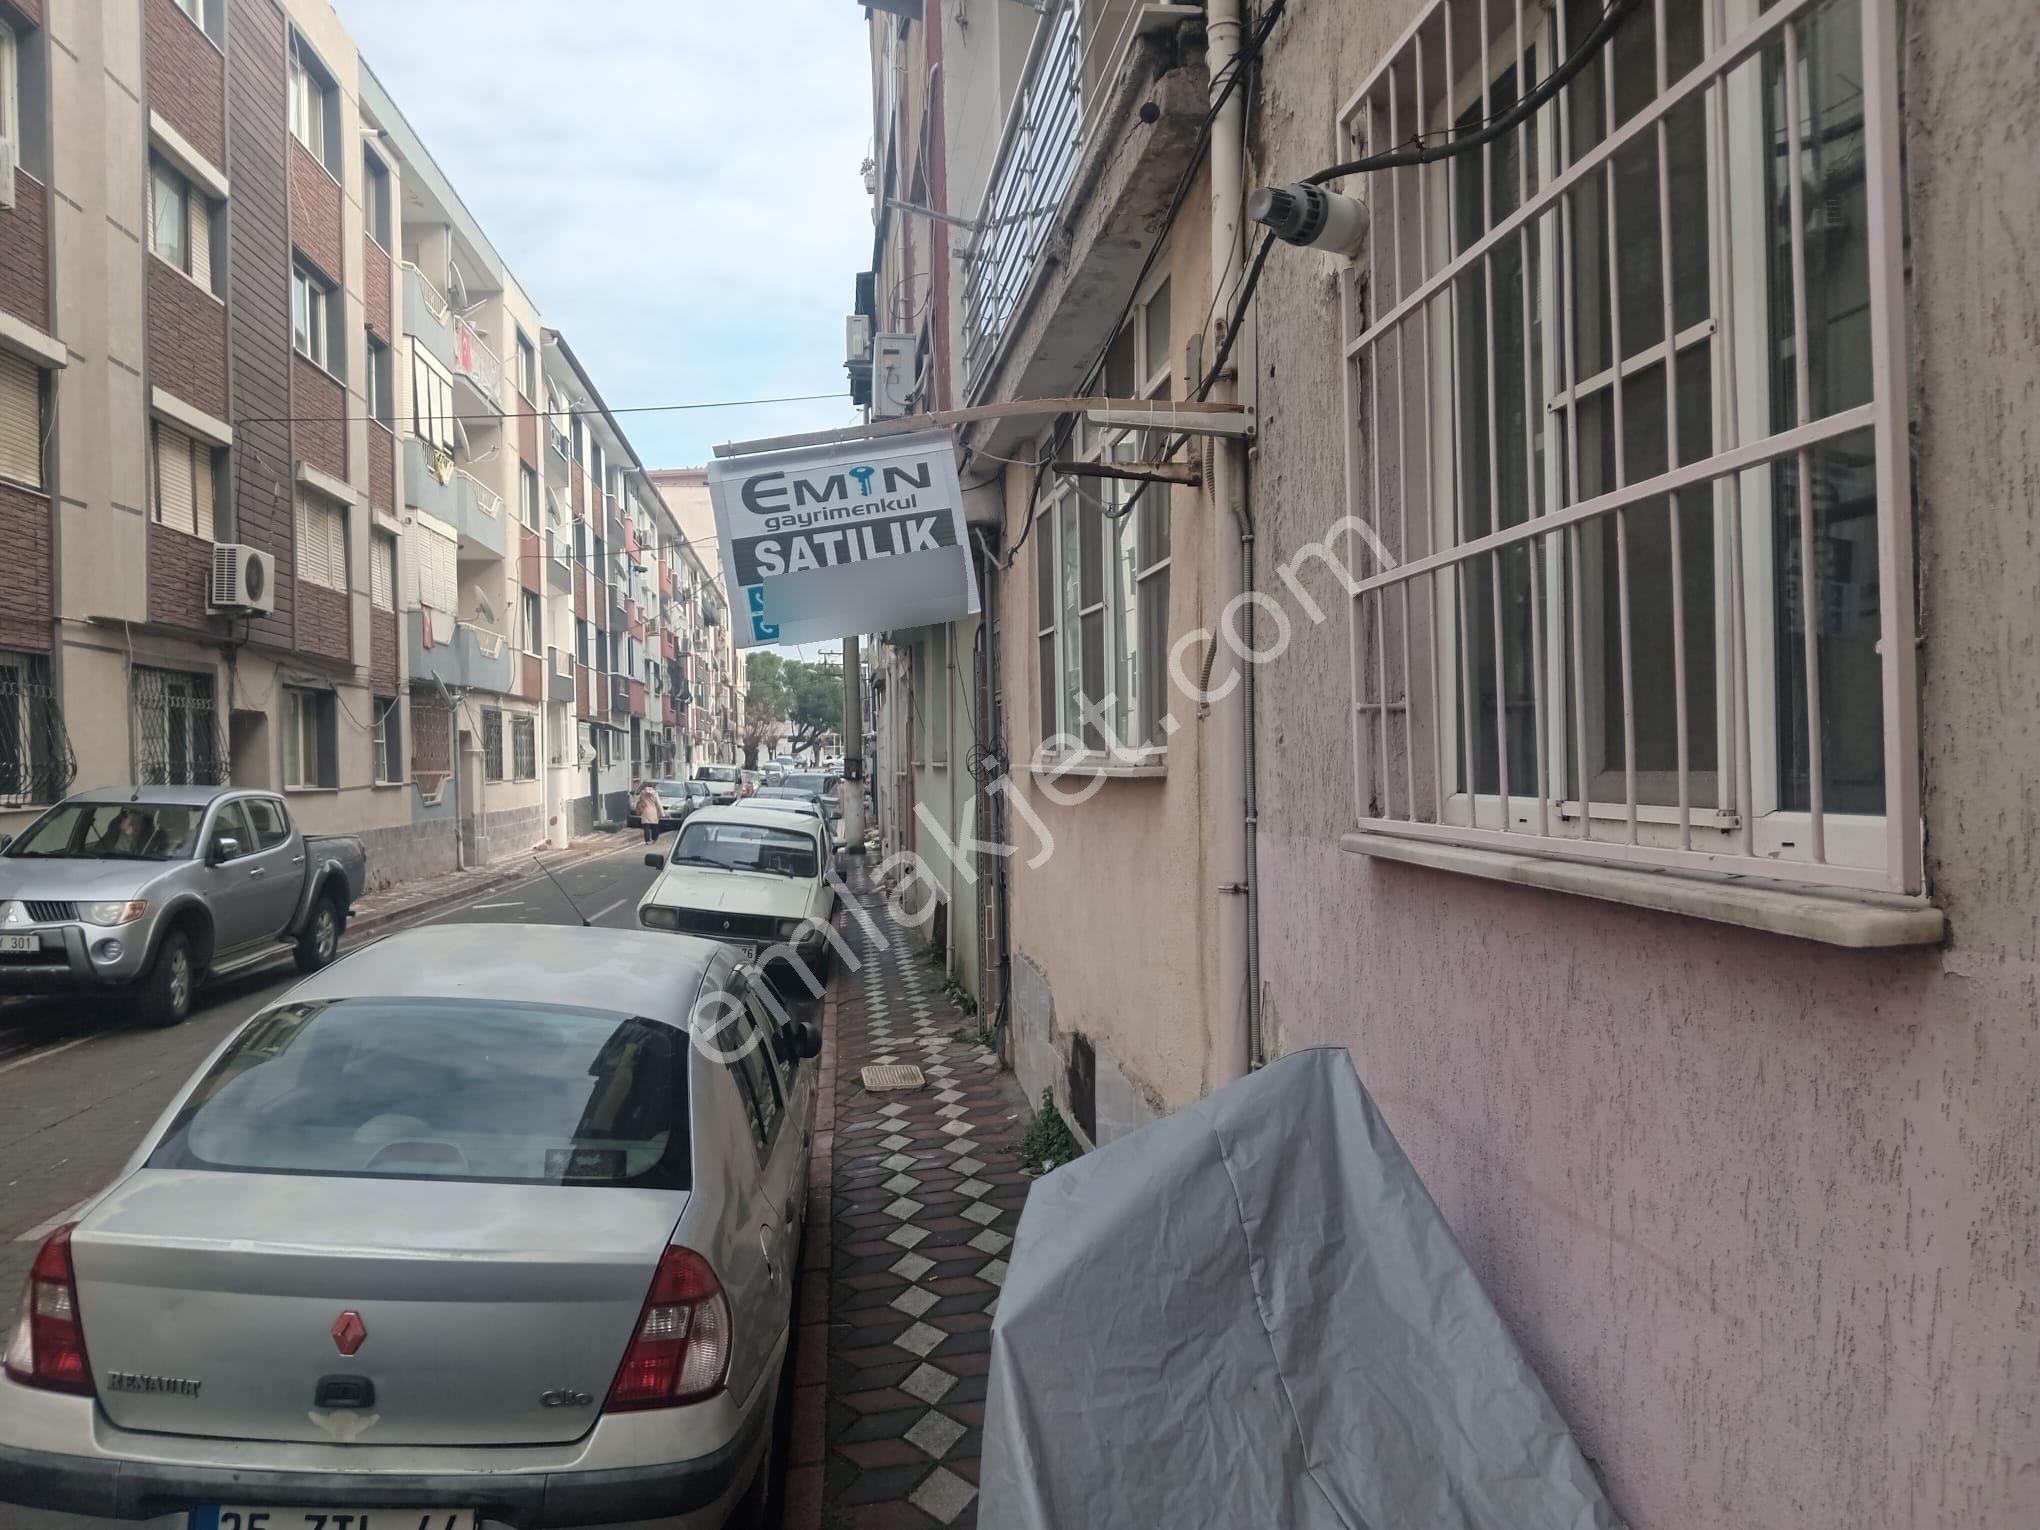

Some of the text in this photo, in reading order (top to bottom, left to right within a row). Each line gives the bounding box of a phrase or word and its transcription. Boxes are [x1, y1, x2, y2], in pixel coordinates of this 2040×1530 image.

[764, 494, 917, 532] gayrimenkul
[754, 516, 940, 577] SATILIK
[11, 937, 30, 949] 301
[540, 1388, 594, 1408] Clio
